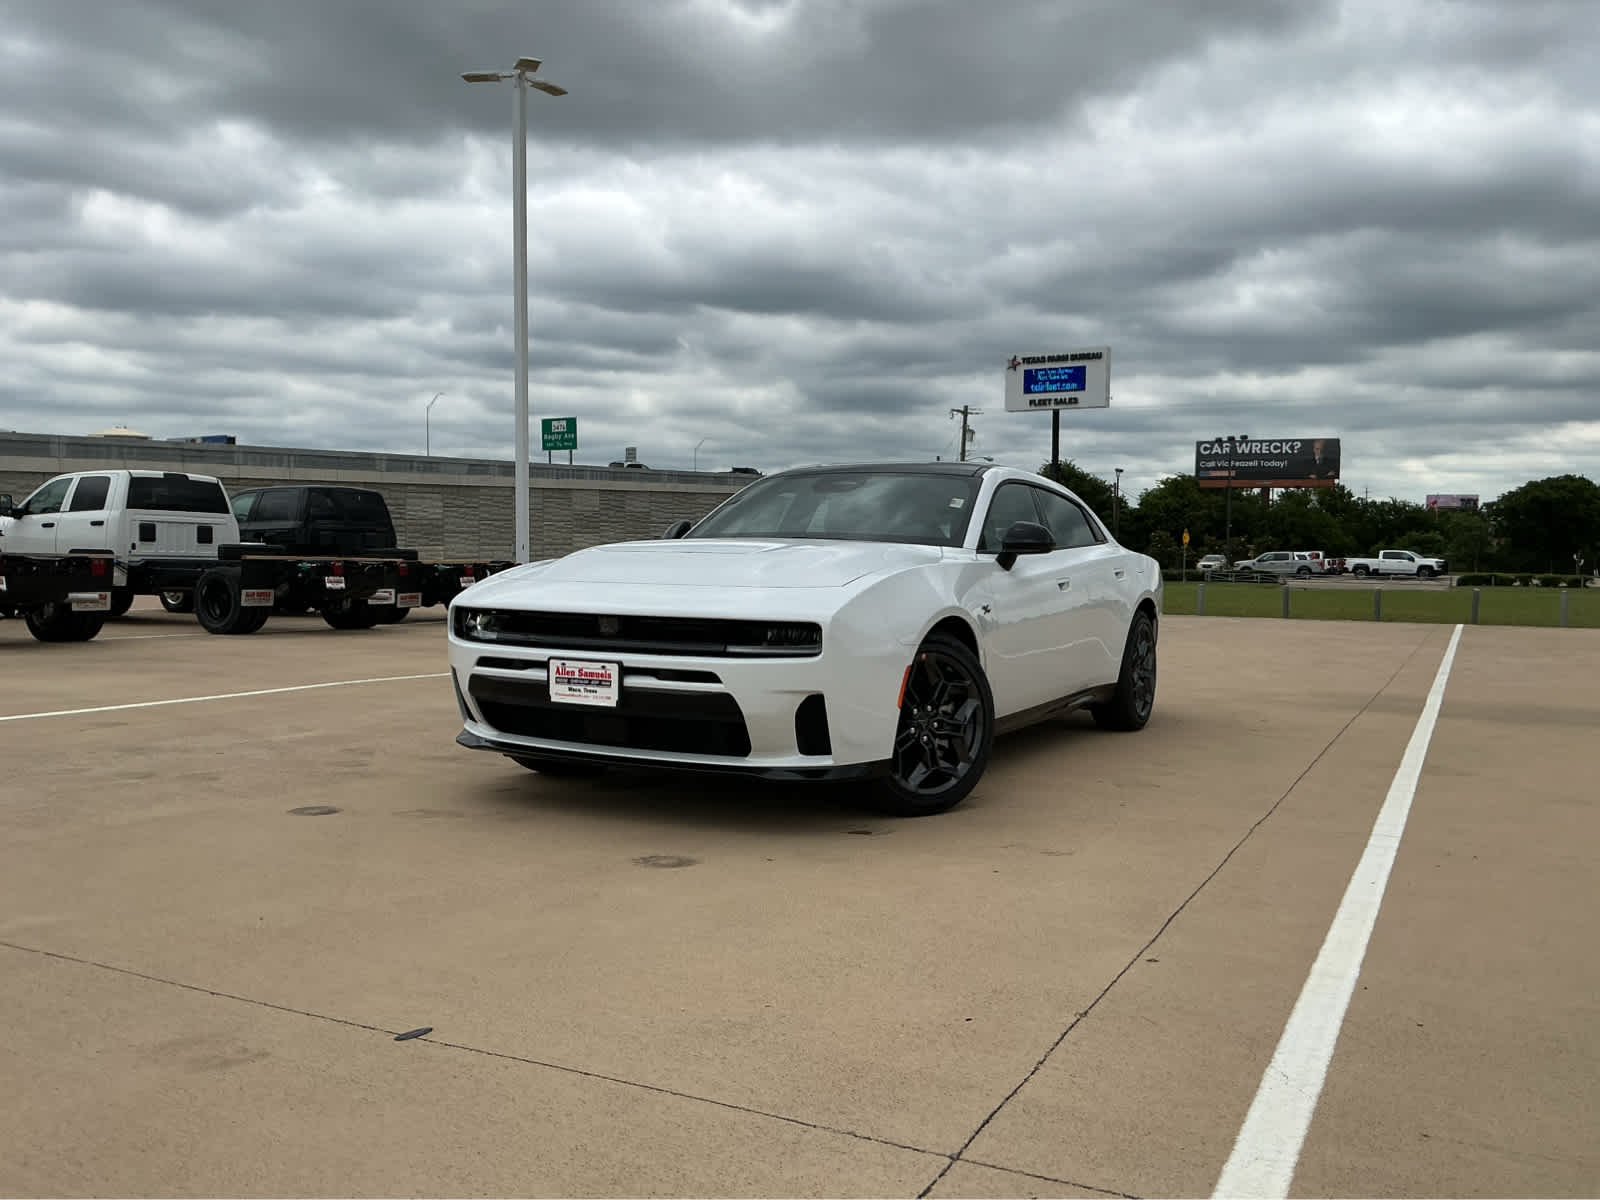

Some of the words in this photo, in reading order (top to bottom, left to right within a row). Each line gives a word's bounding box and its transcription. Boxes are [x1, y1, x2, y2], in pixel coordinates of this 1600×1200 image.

[1029, 398, 1053, 407] FLEET
[1053, 397, 1079, 406] SALES
[1200, 442, 1231, 455] CAR
[1235, 441, 1302, 454] WRECK?
[1200, 460, 1215, 468] Call
[1216, 460, 1229, 468] Vic
[1230, 460, 1258, 468] Feazell
[1260, 460, 1288, 469] Today!
[555, 666, 576, 677] Allen
[577, 668, 612, 679] Samuels
